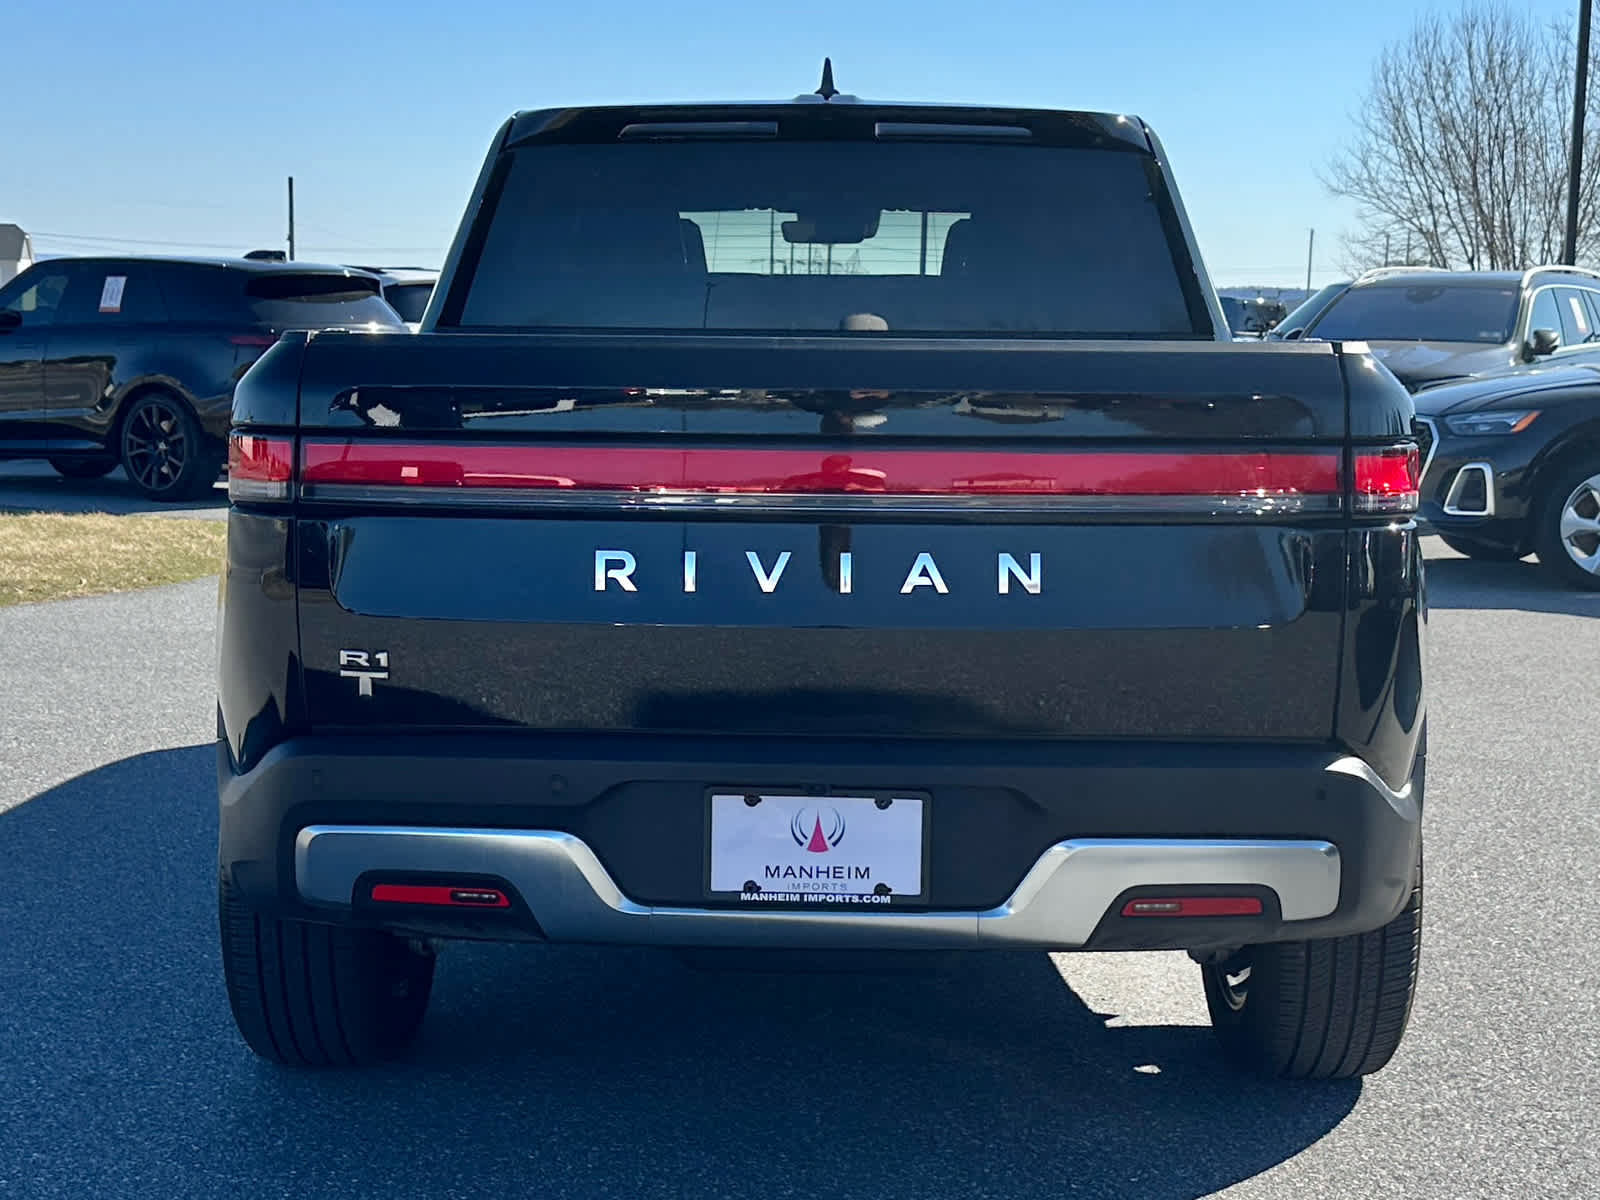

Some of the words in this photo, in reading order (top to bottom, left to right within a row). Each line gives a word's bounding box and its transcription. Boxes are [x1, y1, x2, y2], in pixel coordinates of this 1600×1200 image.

[594, 550, 1041, 593] RIVIAN
[340, 650, 388, 667] R1
[764, 865, 870, 879] MANHEIM
[787, 882, 848, 892] IMPORTS
[740, 892, 800, 902] MANHEIM
[803, 893, 891, 904] IMPORTS.COM
